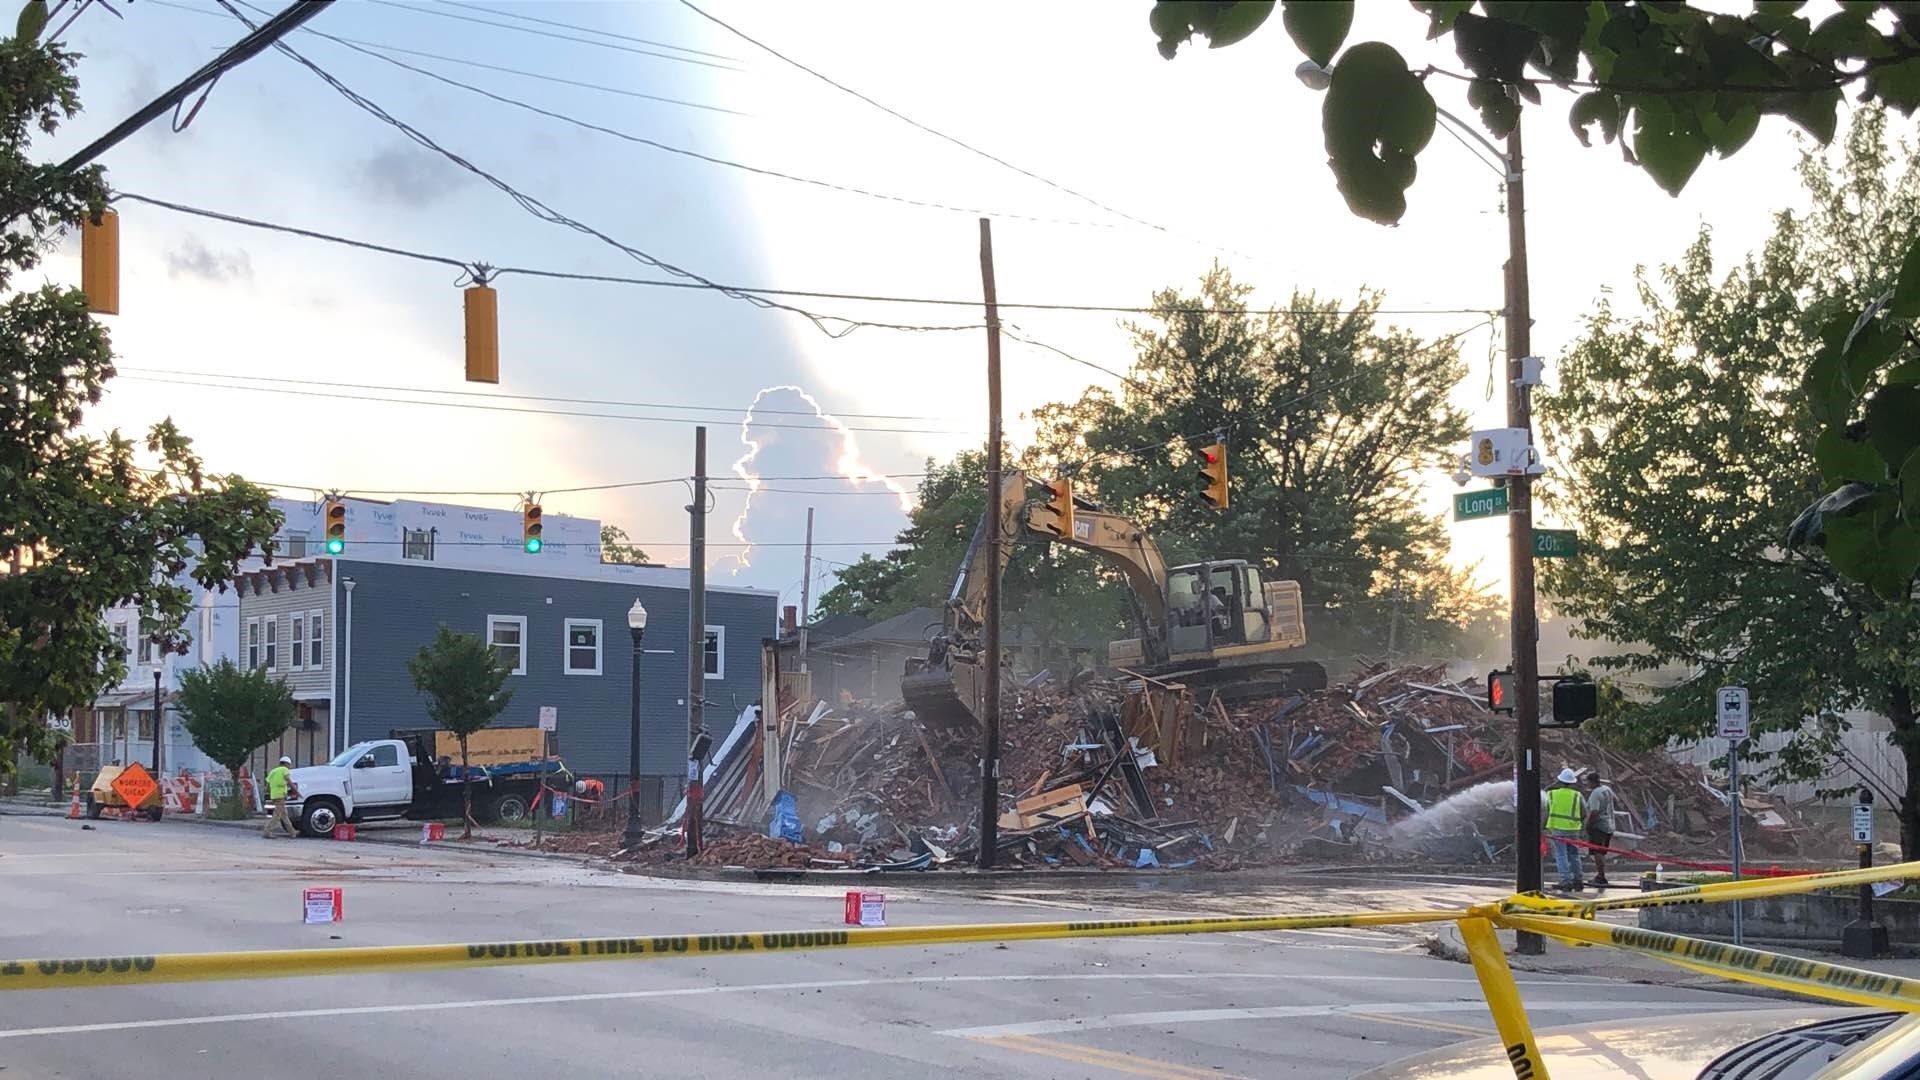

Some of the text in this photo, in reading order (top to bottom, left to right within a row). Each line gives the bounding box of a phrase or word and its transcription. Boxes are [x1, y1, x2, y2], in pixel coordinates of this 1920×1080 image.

[1465, 497, 1493, 515] Long
[373, 510, 393, 521] Tyve
[1074, 520, 1090, 538] CAT
[54, 719, 70, 728] 30
